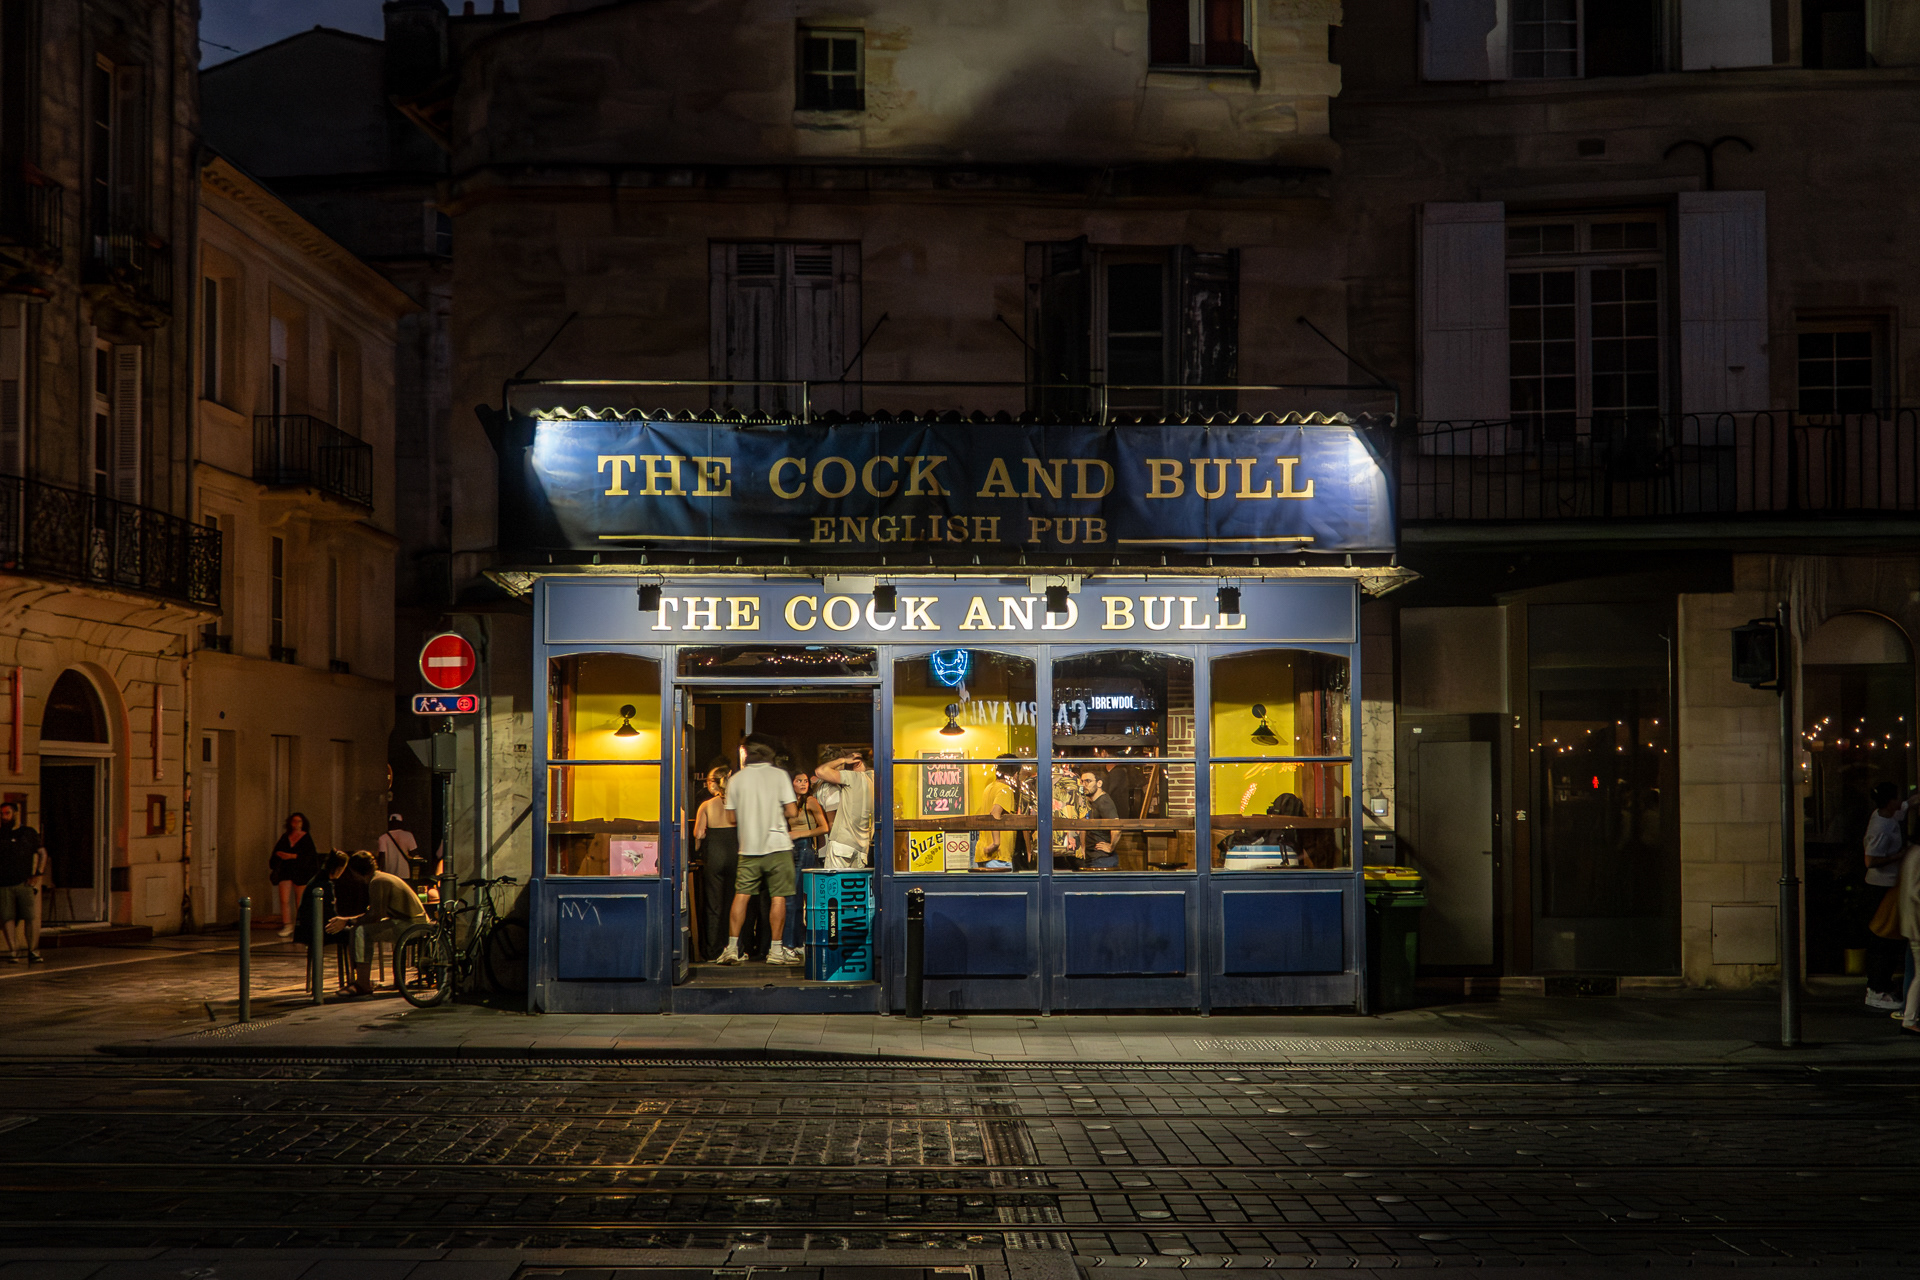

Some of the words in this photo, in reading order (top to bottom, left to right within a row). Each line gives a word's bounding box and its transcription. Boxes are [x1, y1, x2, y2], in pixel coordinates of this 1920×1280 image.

[597, 455, 732, 497] THE
[768, 455, 951, 499] COCK
[976, 457, 1115, 499] AND
[1146, 457, 1314, 500] BULL
[810, 515, 1001, 544] ENGLISH
[1028, 517, 1108, 544] PUB
[651, 596, 760, 631] THE
[784, 595, 941, 631] COCK
[958, 596, 1079, 631] AND
[926, 786, 938, 798] 28
[939, 786, 960, 798] août
[928, 771, 962, 785] KARAOKE
[910, 833, 944, 862] Suze
[841, 878, 867, 973] BREWDOG
